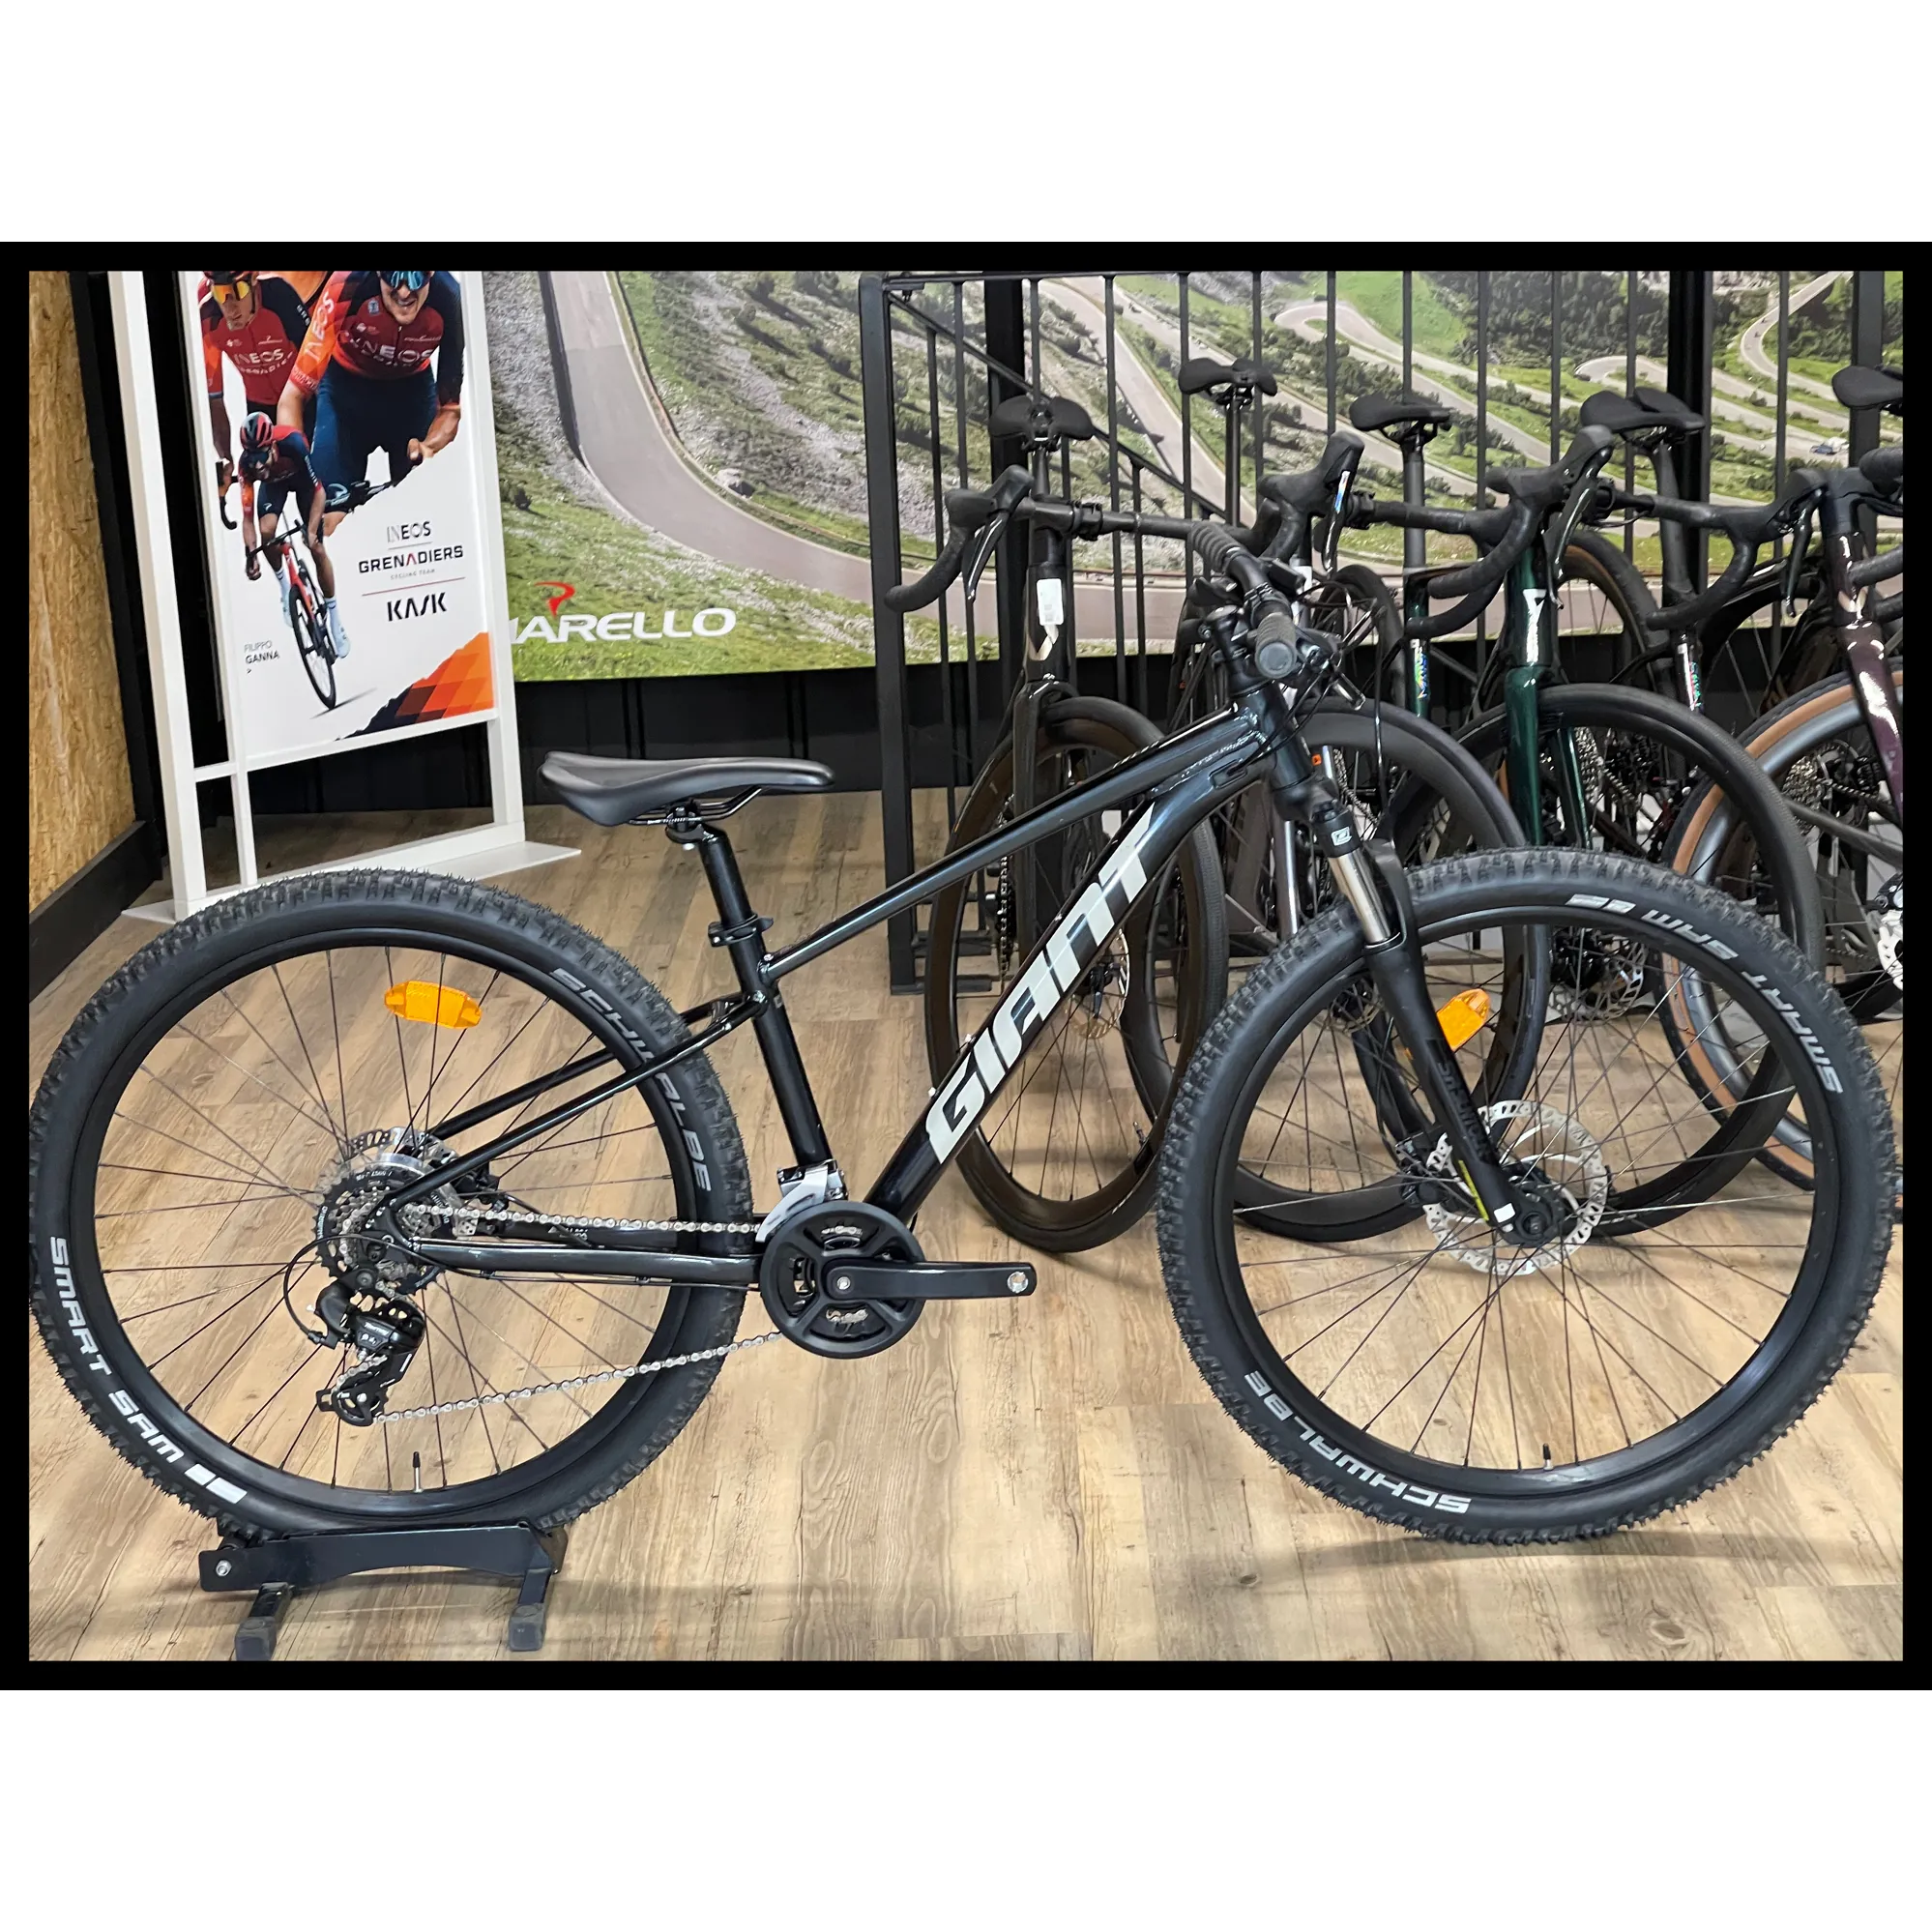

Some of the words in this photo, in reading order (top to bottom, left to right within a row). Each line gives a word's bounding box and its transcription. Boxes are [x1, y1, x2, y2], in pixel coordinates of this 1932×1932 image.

[387, 520, 431, 543] INEOS
[358, 544, 464, 573] GRENADIERS
[387, 592, 447, 622] KASK
[509, 607, 737, 645] ARELLO
[245, 651, 280, 664] GANNA
[1641, 909, 1739, 959] SAM
[925, 801, 1156, 1165] GIANT
[1741, 970, 1843, 1094] SMART
[50, 1236, 112, 1376] SMART
[108, 1390, 185, 1464] SAM
[1244, 1370, 1473, 1514] SCHWALBE
